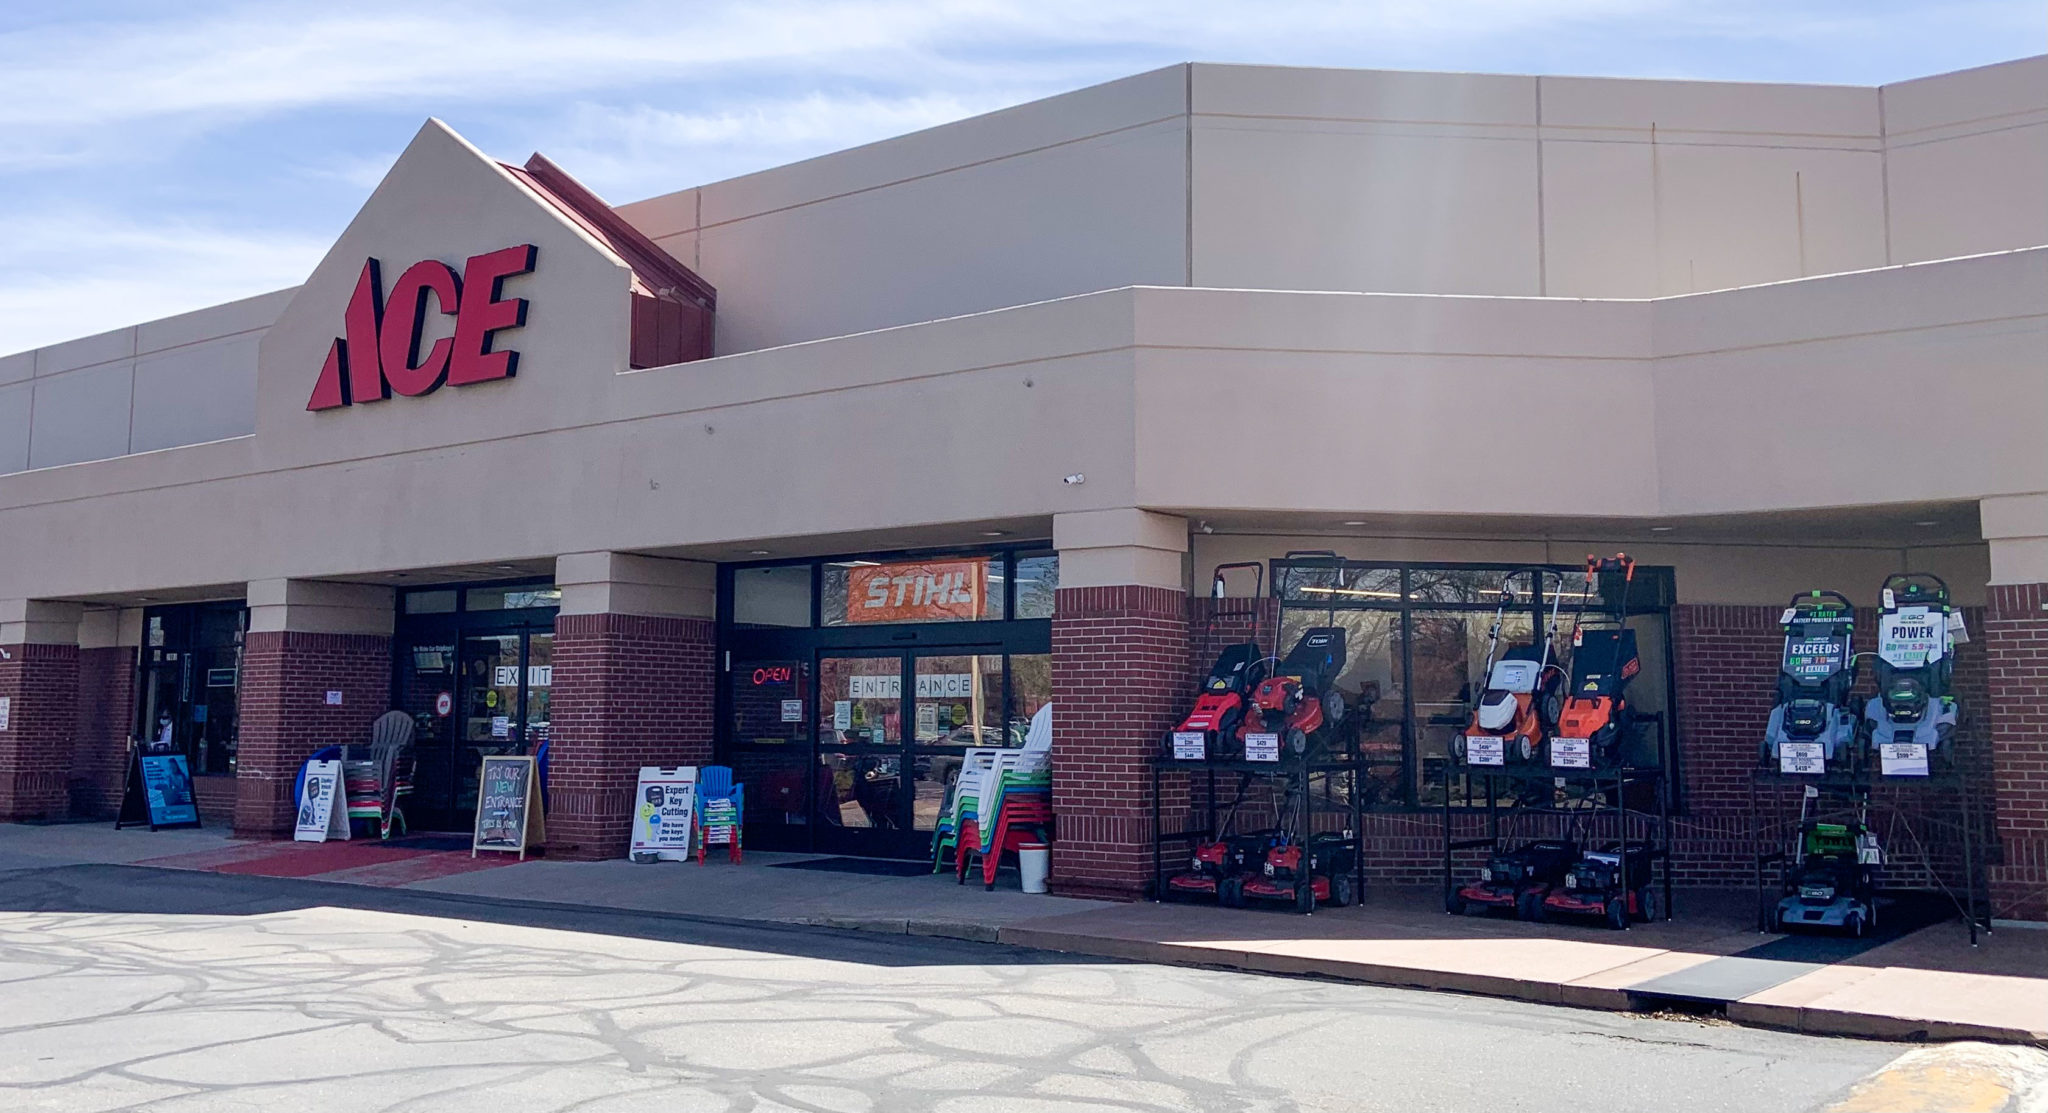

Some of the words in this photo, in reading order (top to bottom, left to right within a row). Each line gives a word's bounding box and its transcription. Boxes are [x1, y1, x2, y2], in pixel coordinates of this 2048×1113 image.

[307, 244, 537, 411] ACE
[864, 572, 971, 608] STIHL
[1891, 626, 1934, 639] POWER
[1792, 643, 1840, 655] EXCEEDS
[496, 668, 551, 685] EXIT
[753, 667, 791, 685] OPEN
[852, 679, 970, 693] ENTRANCE
[488, 766, 503, 780] TRY
[505, 767, 520, 780] OUR
[495, 780, 516, 794] NEW
[665, 786, 689, 795] Expert
[485, 795, 524, 809] ENTRANCE
[669, 797, 683, 806] Key
[661, 807, 688, 817] Cutting
